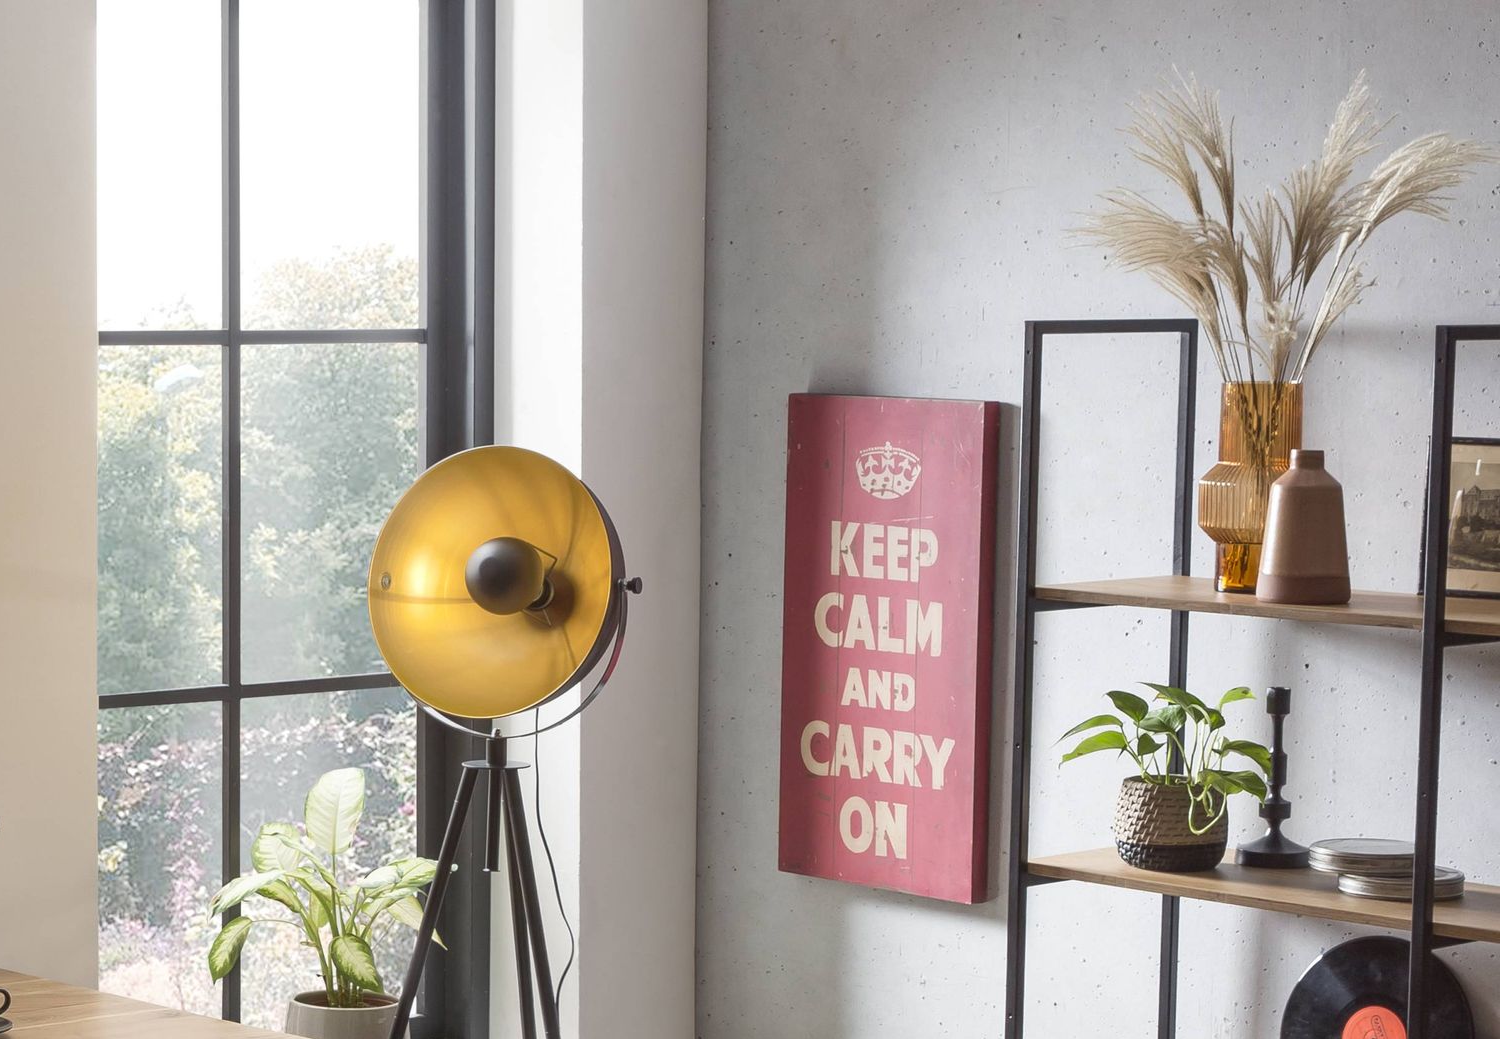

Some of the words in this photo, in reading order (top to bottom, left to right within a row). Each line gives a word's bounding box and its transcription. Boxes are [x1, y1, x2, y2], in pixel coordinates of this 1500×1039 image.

[831, 520, 938, 582] KEEP
[814, 592, 942, 657] CALM
[841, 668, 915, 712] AND
[801, 721, 955, 790] CARRY
[839, 796, 908, 860] ON
